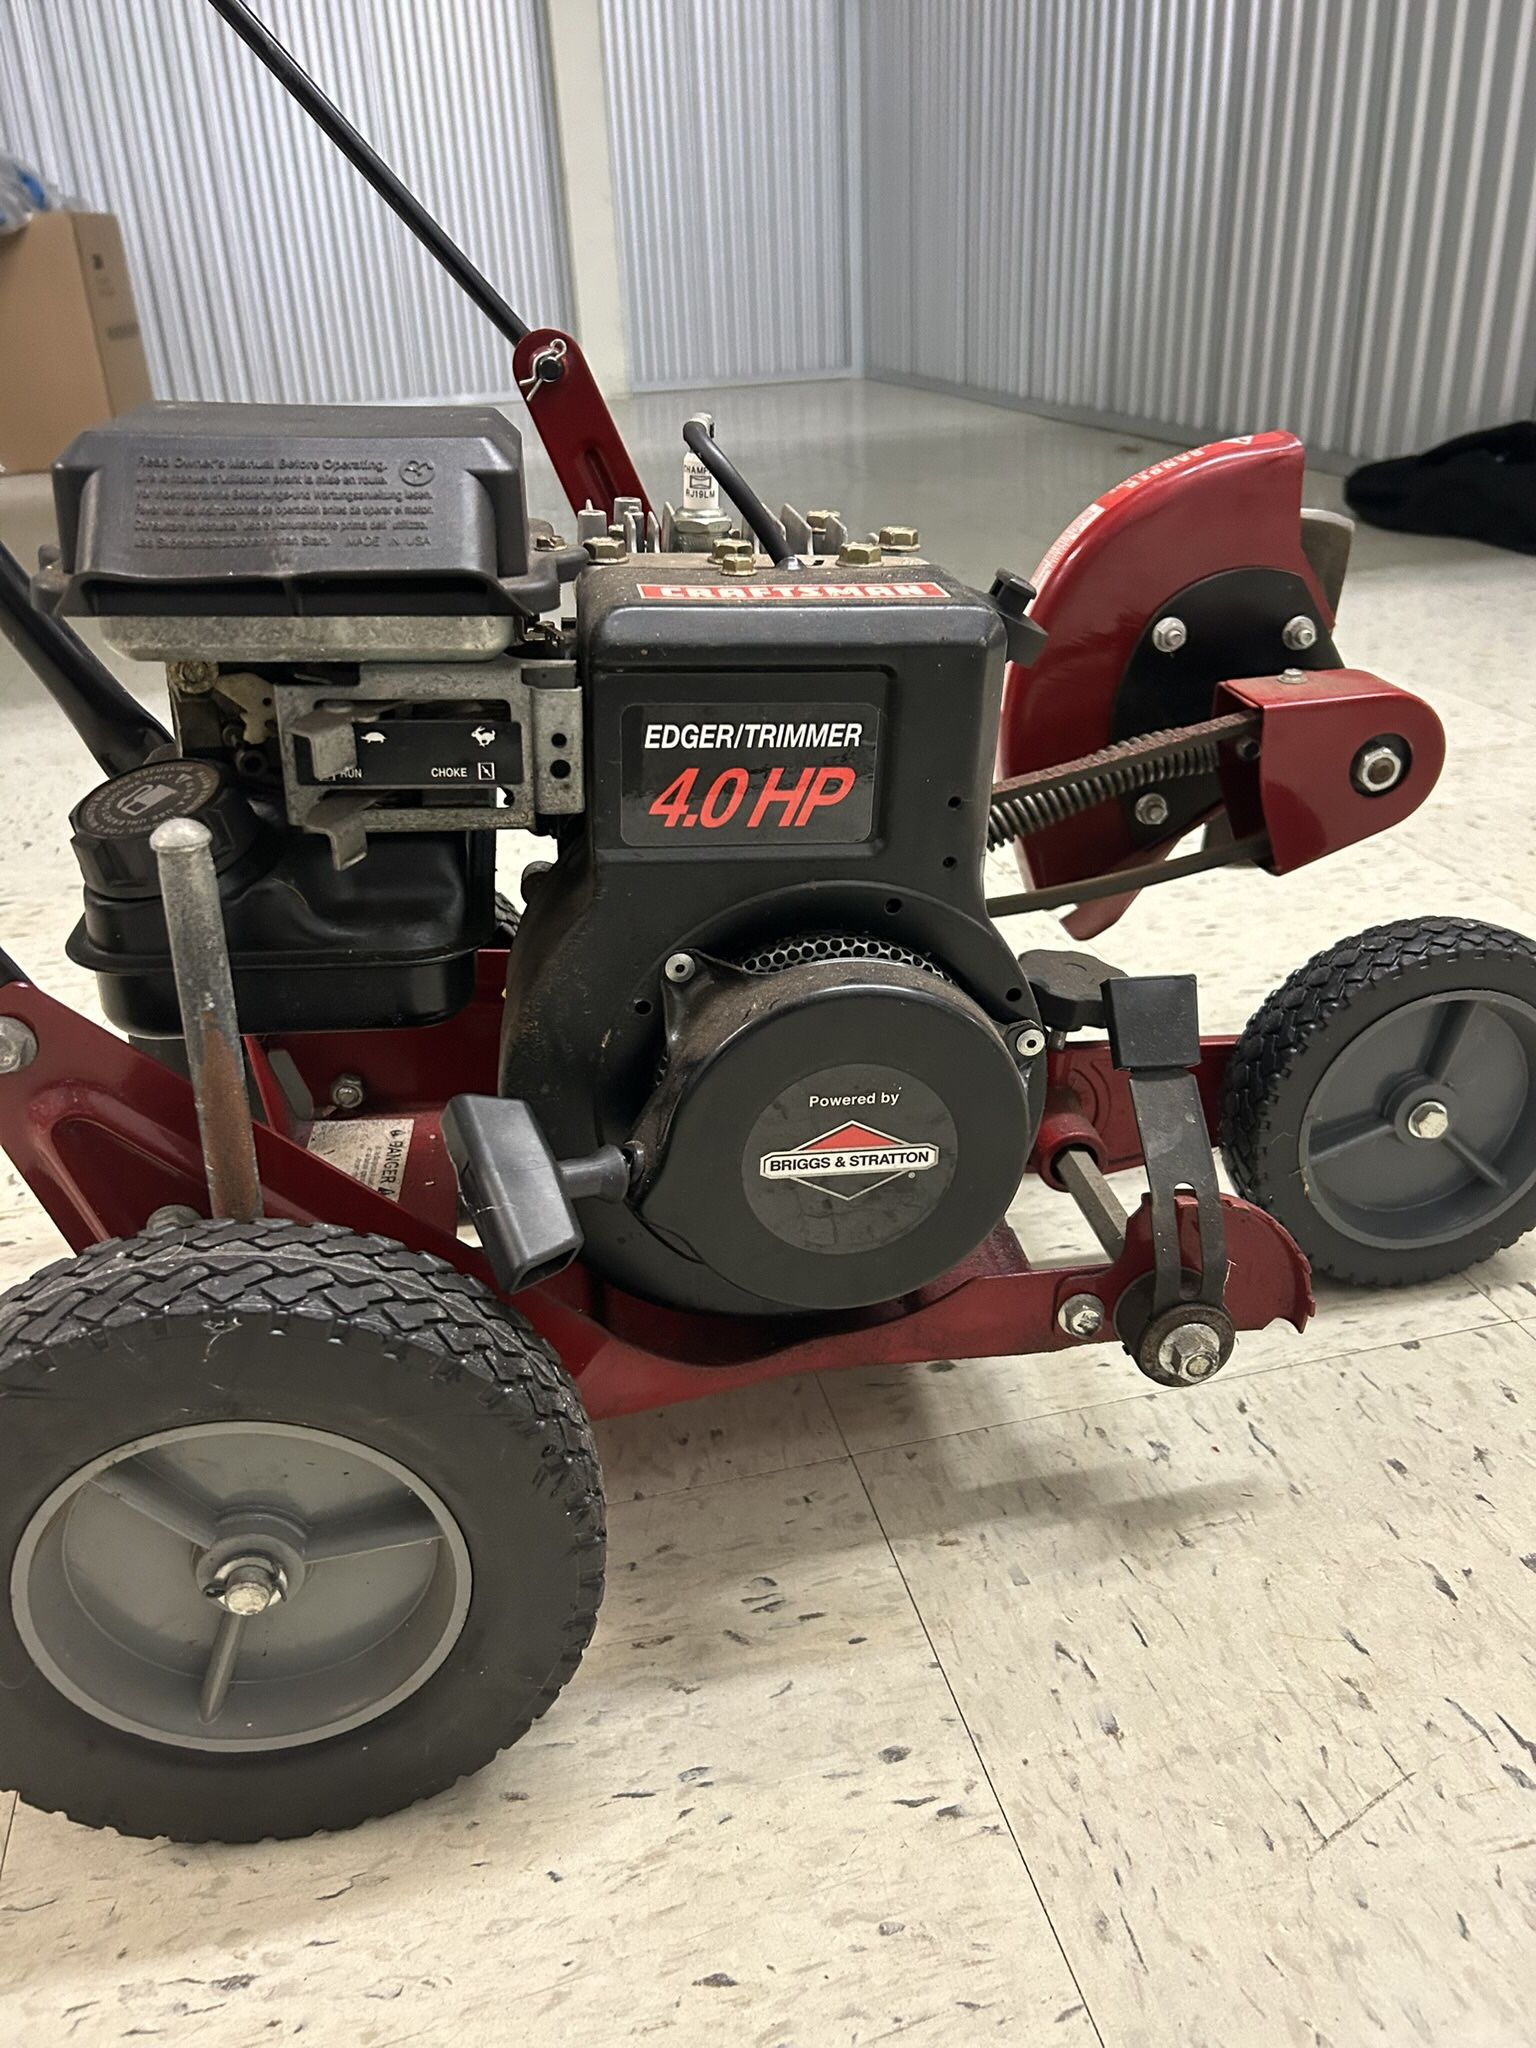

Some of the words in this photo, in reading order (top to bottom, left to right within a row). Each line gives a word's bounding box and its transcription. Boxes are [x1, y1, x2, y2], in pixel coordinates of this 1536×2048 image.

[137, 455, 168, 468] Read
[175, 456, 224, 469] Owner's
[229, 457, 275, 470] Manual
[279, 457, 320, 470] Before
[322, 459, 388, 473] Operating.
[659, 584, 929, 598] CRAFTSMAN
[644, 723, 863, 749] EDGER/TRIMMER
[430, 767, 468, 779] CHOKE
[648, 767, 750, 829] 4.0
[747, 767, 857, 828] HP
[809, 1092, 876, 1107] Powered
[881, 1091, 900, 1106] by
[770, 1156, 831, 1171] BRIGGS
[834, 1156, 846, 1168] &
[849, 1151, 929, 1167] STRATTON
